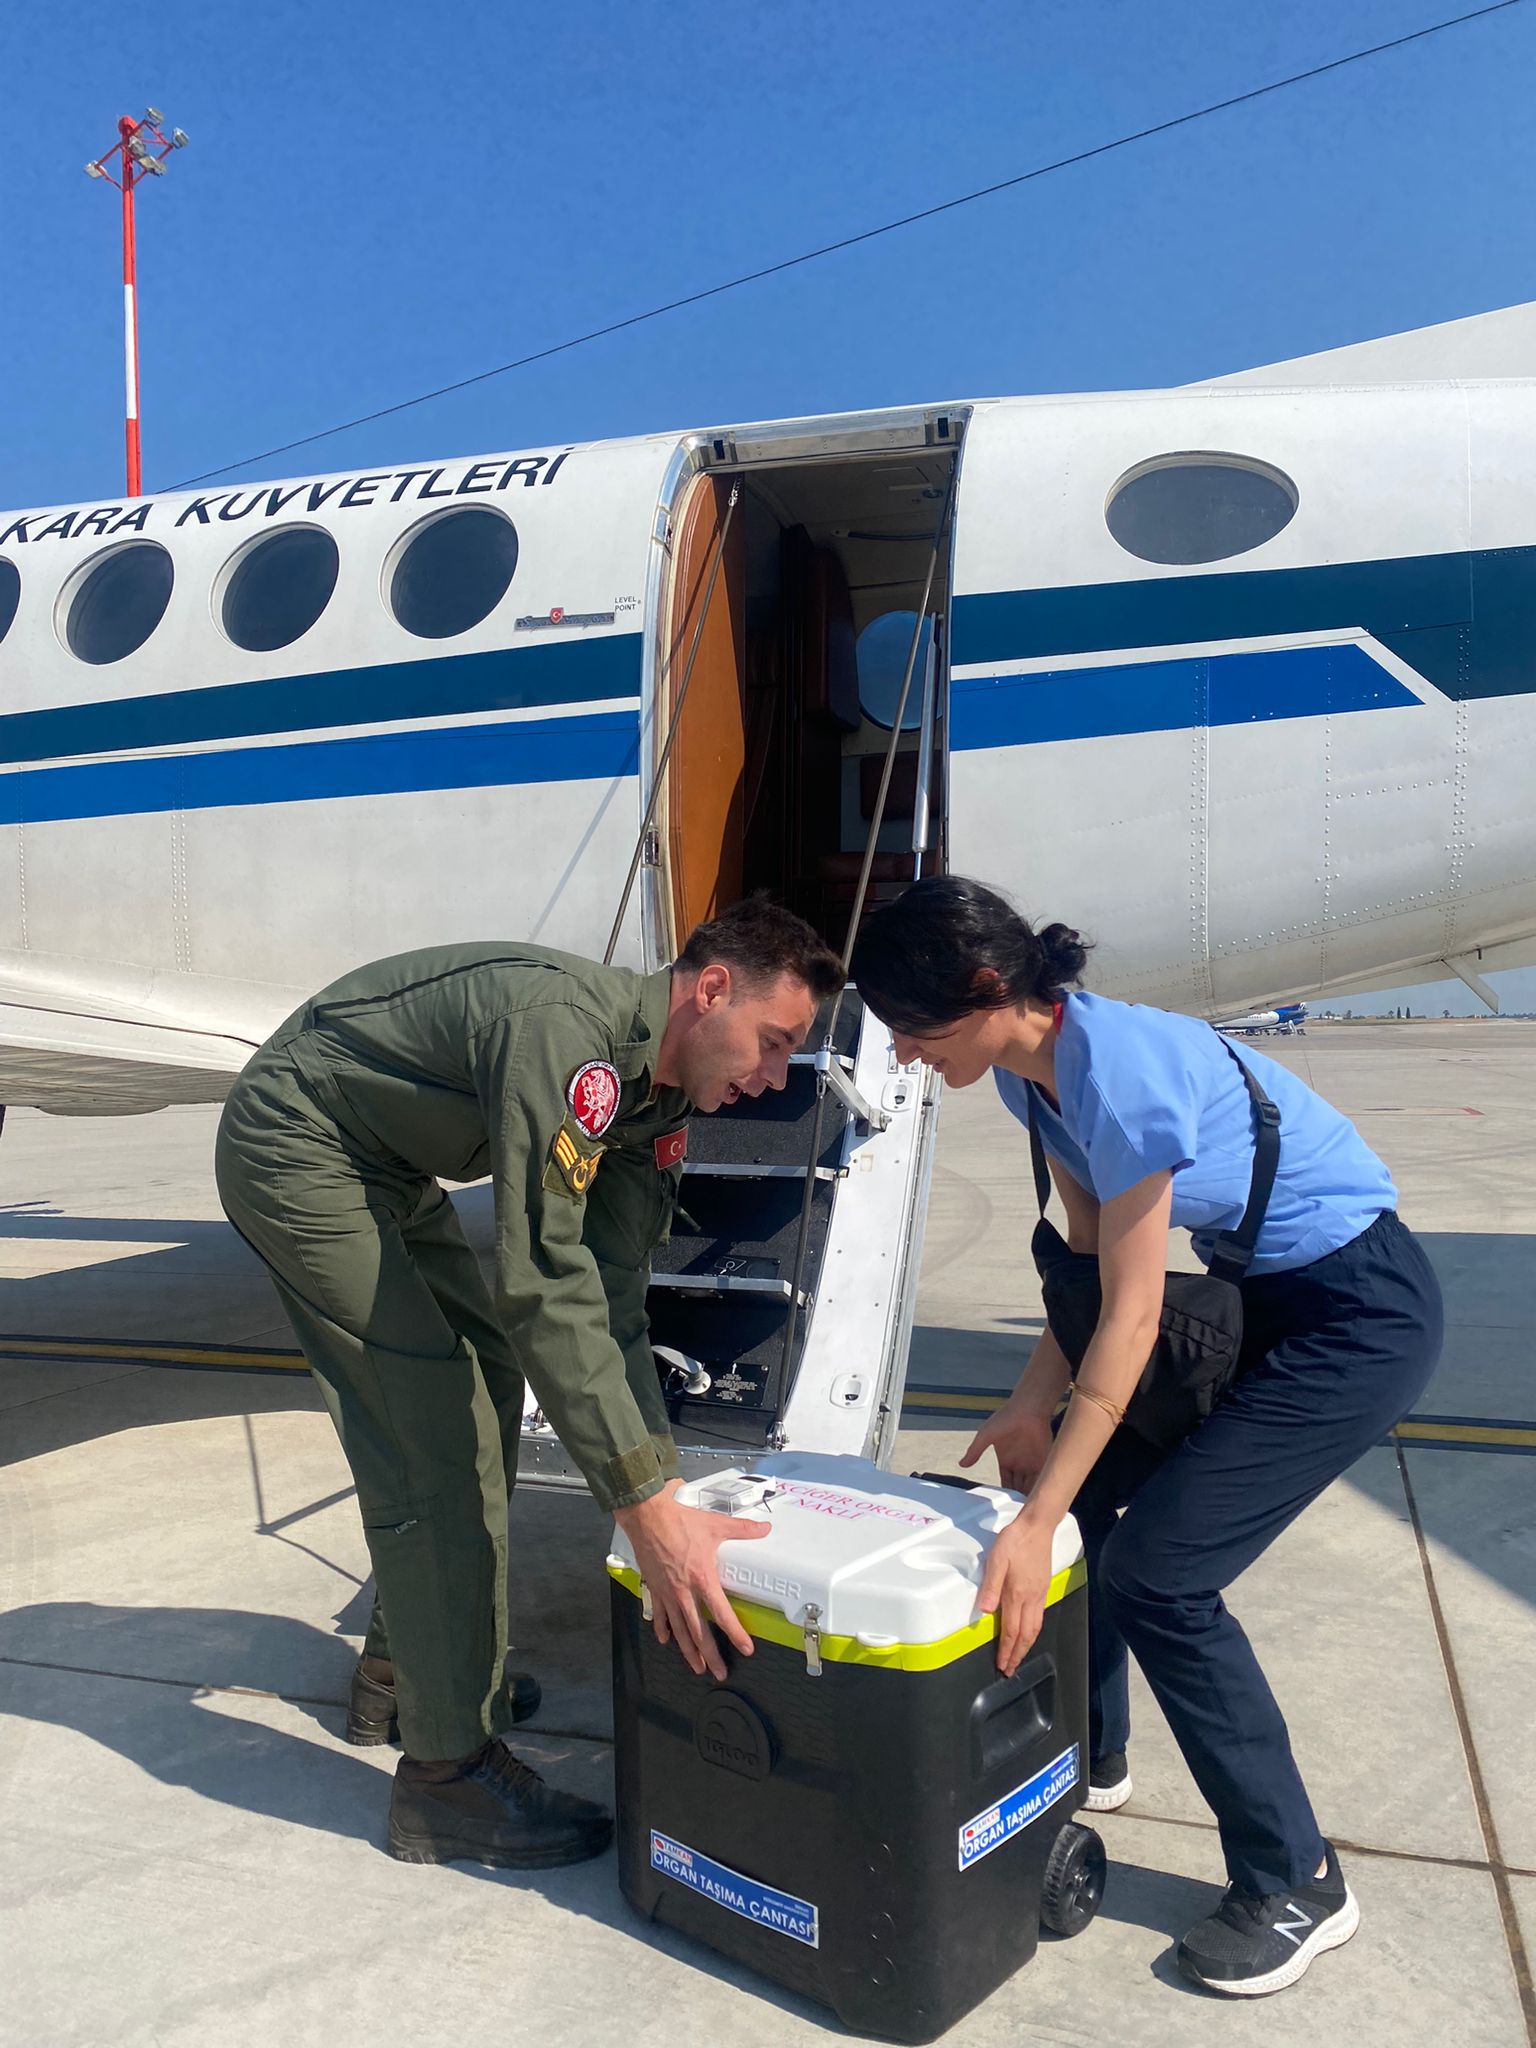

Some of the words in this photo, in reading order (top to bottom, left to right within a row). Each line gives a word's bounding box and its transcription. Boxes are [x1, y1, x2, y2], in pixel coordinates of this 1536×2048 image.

[0, 503, 154, 545] KARA
[174, 446, 576, 528] KUVVETLERİ
[614, 596, 637, 604] LEVEL
[614, 604, 636, 612] POINT
[722, 1561, 802, 1601] ROLLER
[964, 1820, 1005, 1859] ORGAN
[1005, 1795, 1042, 1830] TAŞIMA
[653, 1851, 698, 1885] ORGAN
[700, 1874, 746, 1911] TAŞIMA
[749, 1901, 811, 1938] ÇANTASI
